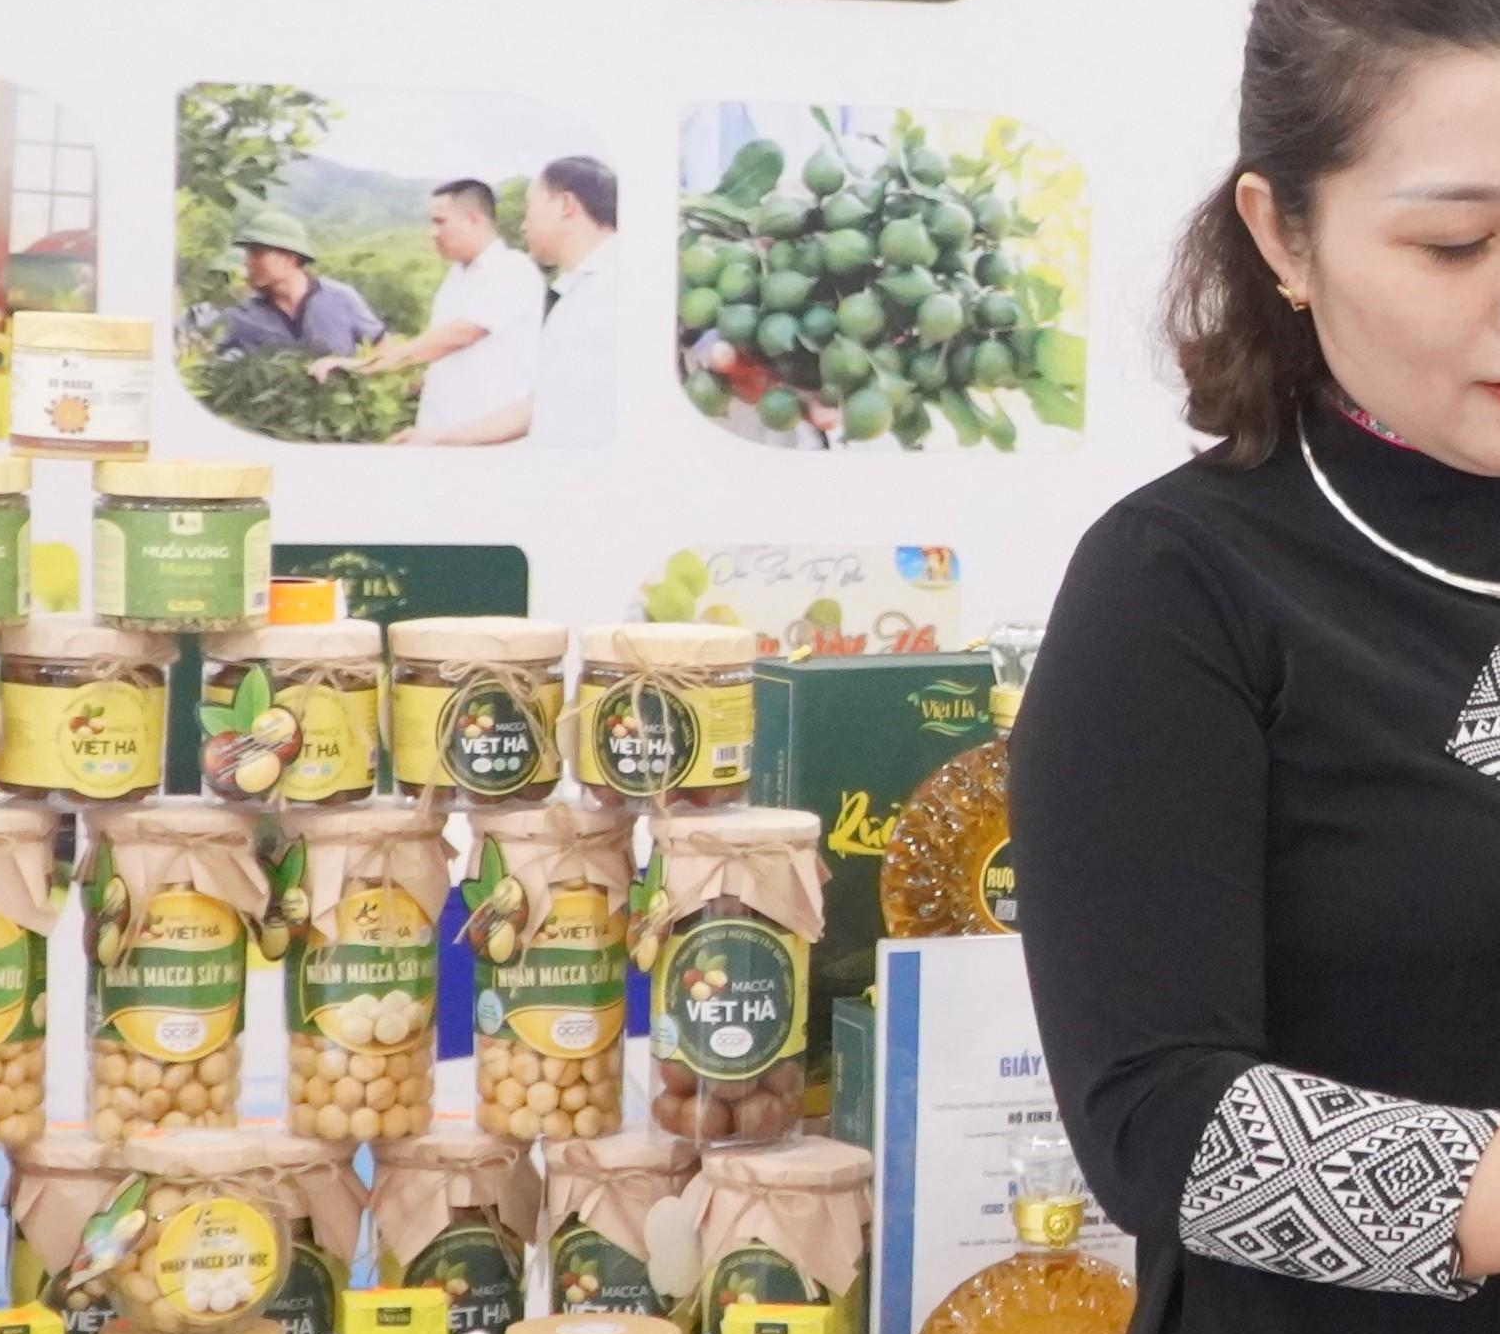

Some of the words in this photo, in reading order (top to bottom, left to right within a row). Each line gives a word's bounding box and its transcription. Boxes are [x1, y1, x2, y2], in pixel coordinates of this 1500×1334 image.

[144, 966, 193, 988] MACCA
[346, 961, 394, 982] MACCA
[539, 965, 588, 988] MACCA
[731, 979, 775, 993] MACCA
[686, 996, 738, 1025] VIỆT
[742, 995, 776, 1022] HÀ
